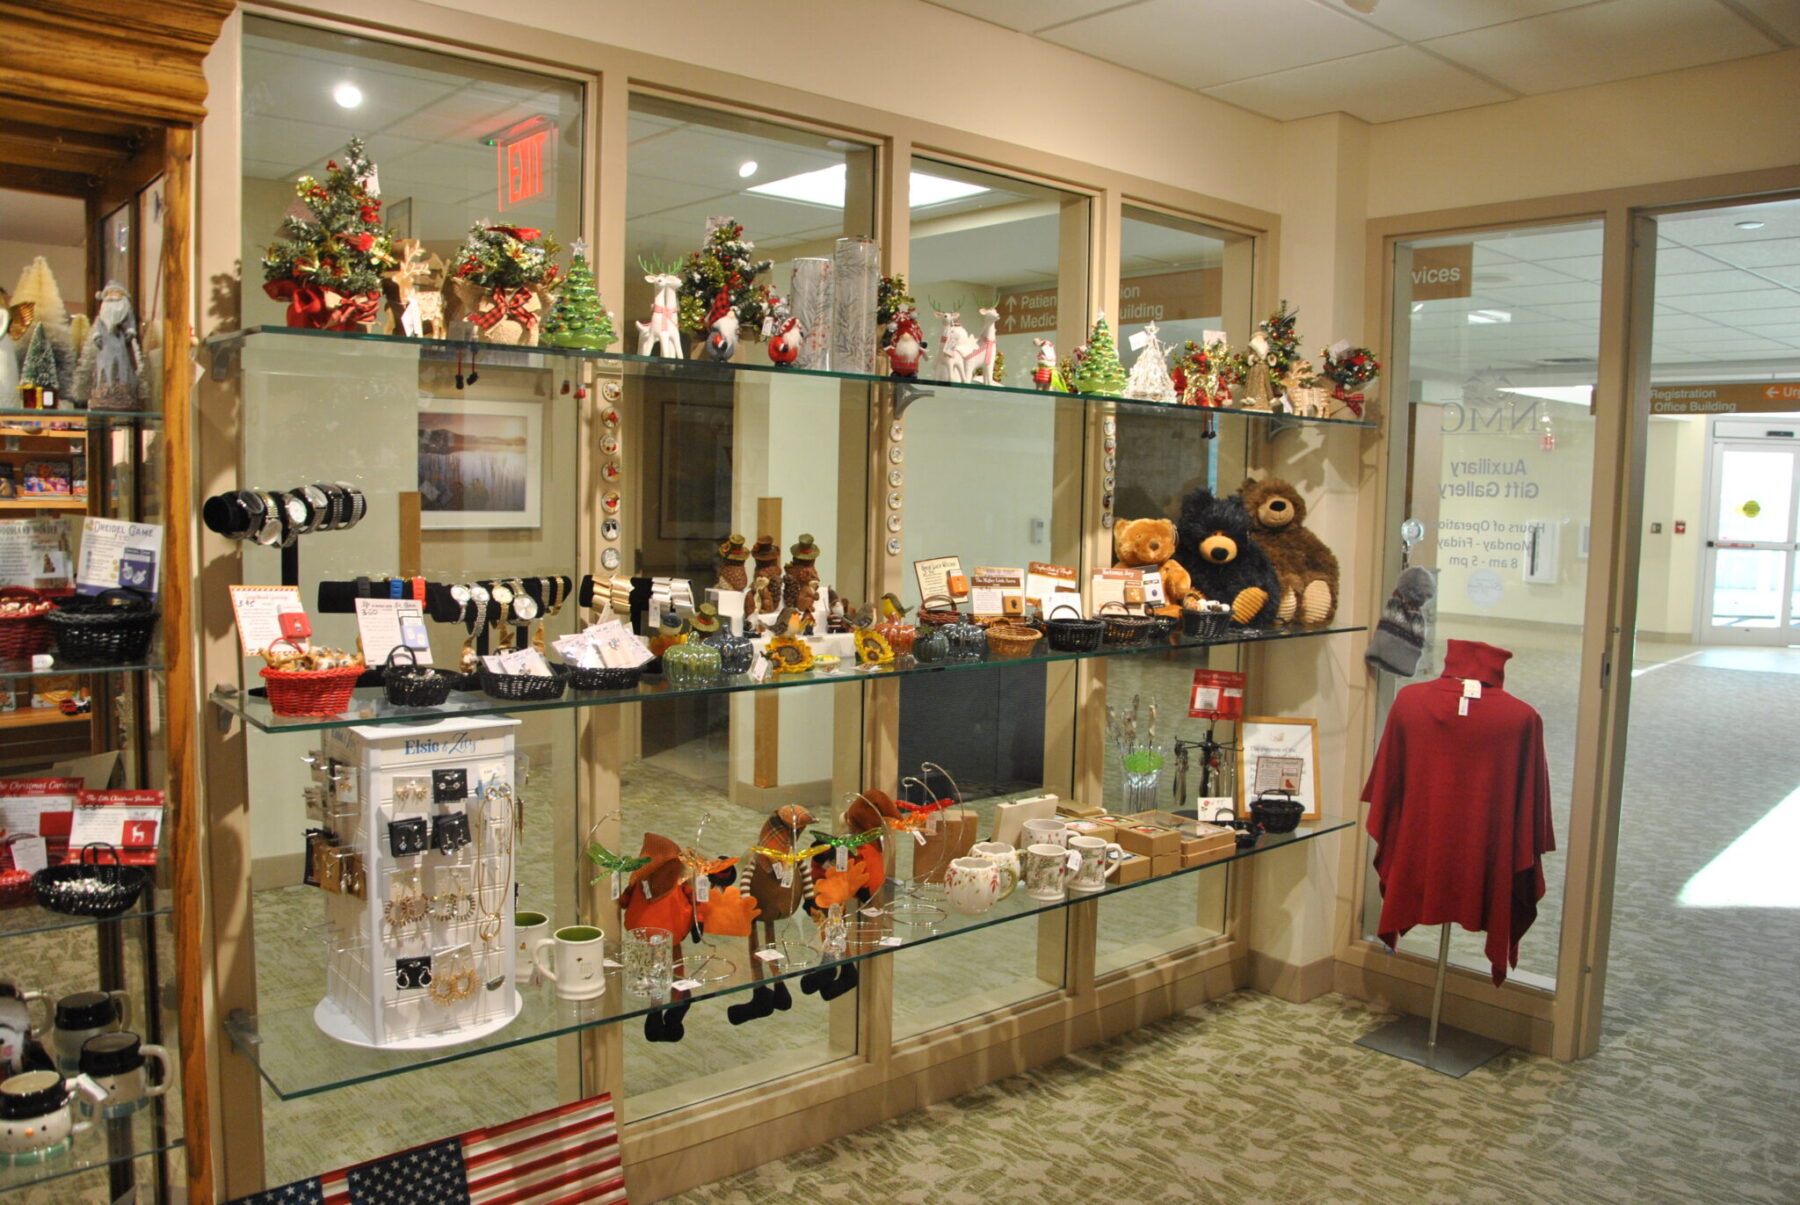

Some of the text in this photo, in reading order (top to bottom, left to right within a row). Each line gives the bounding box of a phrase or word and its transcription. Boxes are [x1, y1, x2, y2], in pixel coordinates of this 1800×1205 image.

[507, 131, 546, 204] EXIT
[1412, 265, 1461, 285] vices
[1021, 284, 1140, 310] Patien ion
[1020, 303, 1164, 329] Medic uilding
[1649, 388, 1717, 402] Registration
[1654, 400, 1737, 413] Office Building
